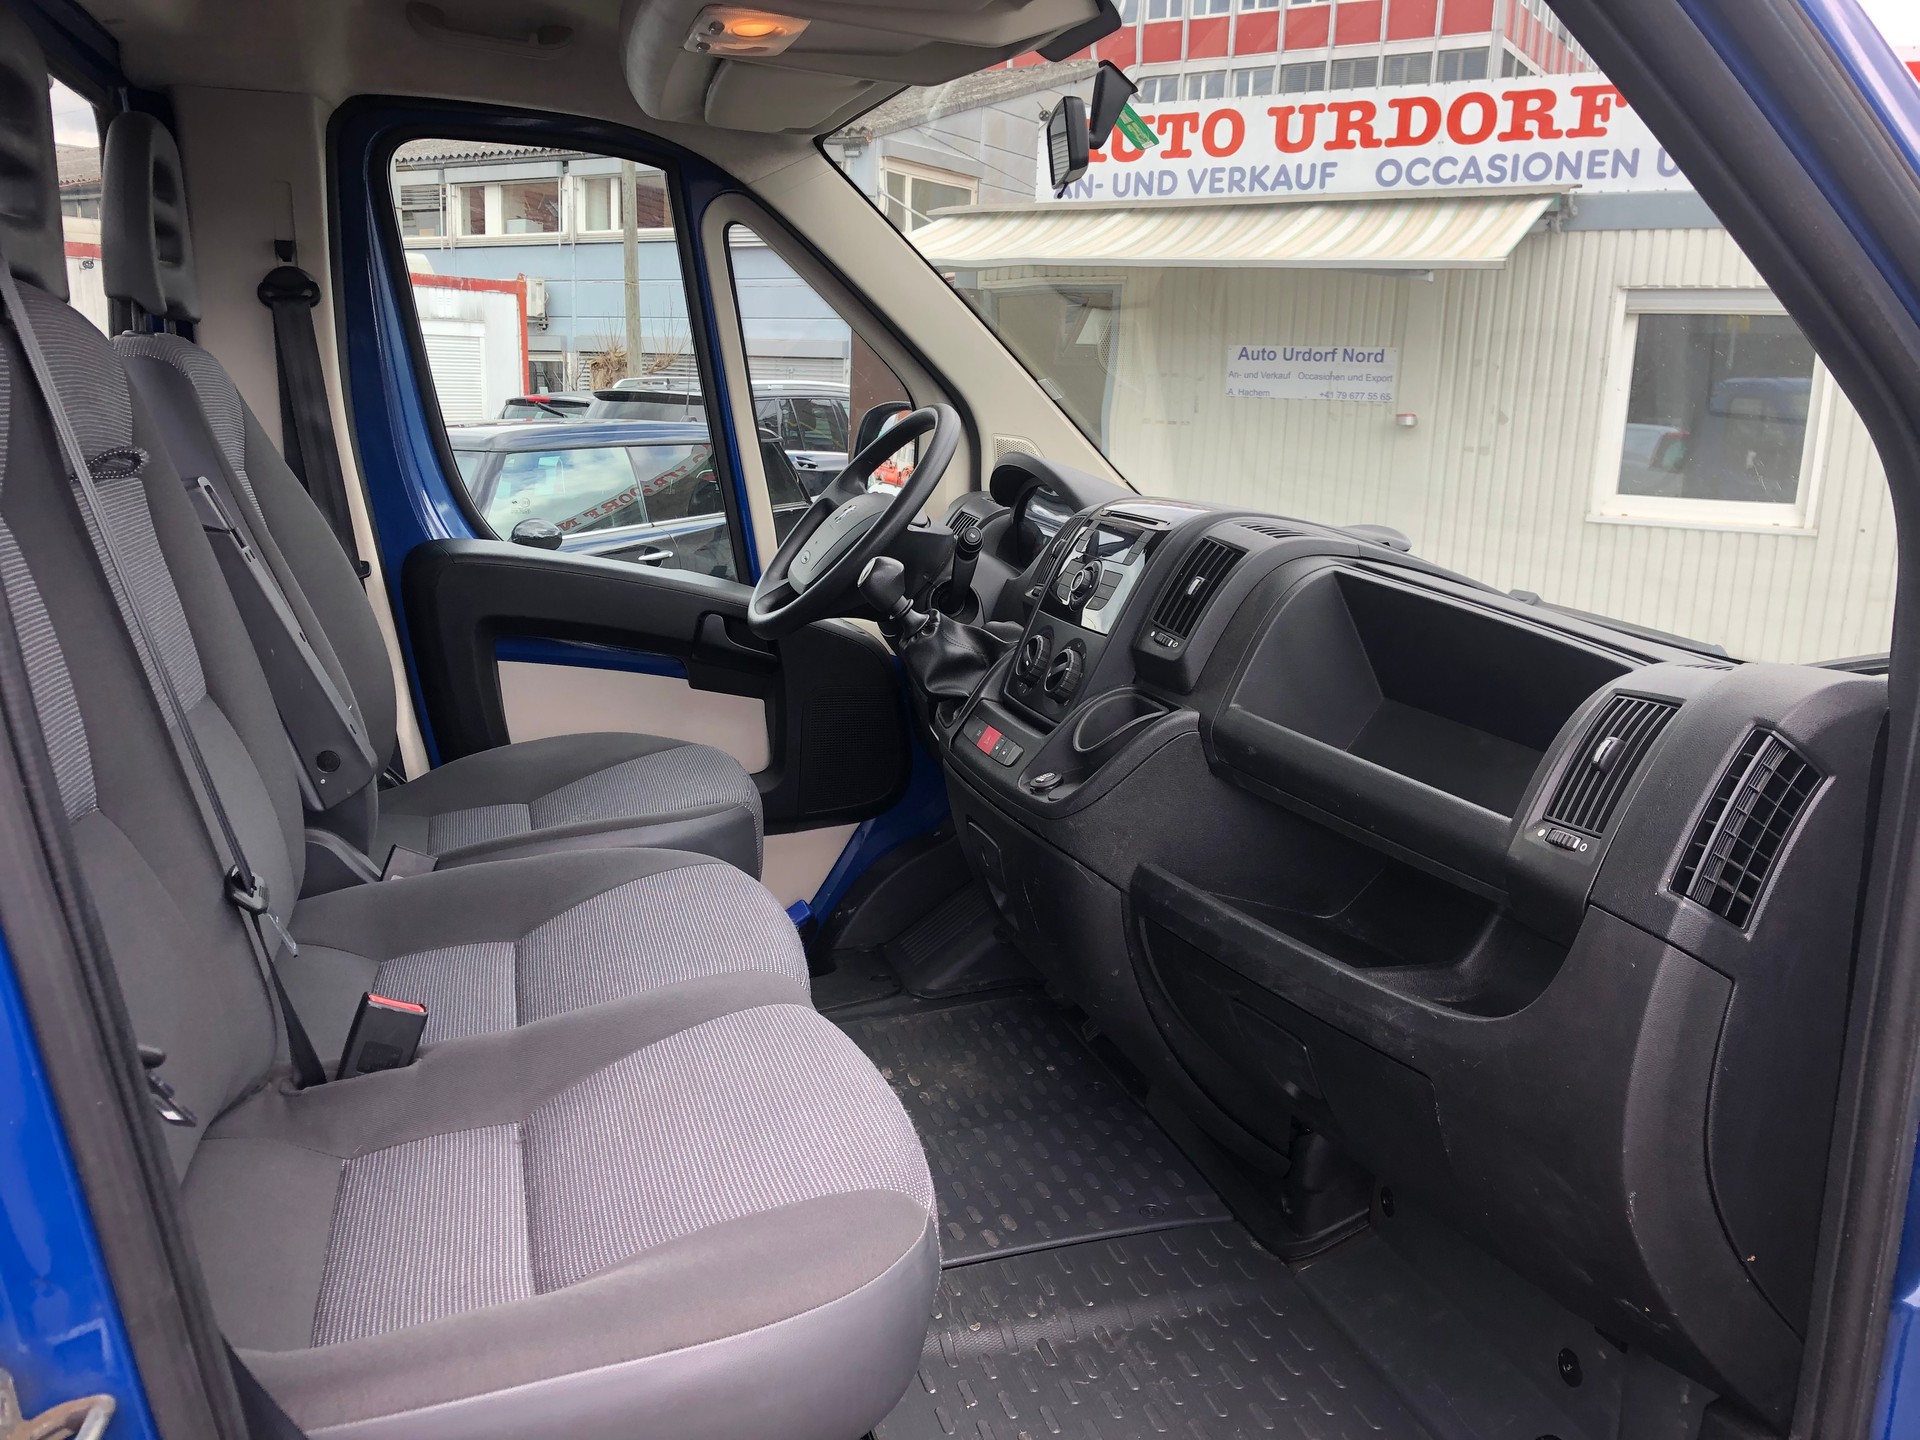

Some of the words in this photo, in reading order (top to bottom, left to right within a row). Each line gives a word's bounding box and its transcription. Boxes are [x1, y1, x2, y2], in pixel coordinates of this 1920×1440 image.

[1088, 108, 1245, 163] UTO
[1267, 84, 1629, 154] URDORF
[1113, 169, 1178, 198] UND
[1187, 161, 1338, 194] VERKAUF
[1375, 148, 1641, 188] OCCASIONEN
[1238, 346, 1277, 362] Auto
[1283, 347, 1338, 363] Urdorf
[1342, 348, 1385, 364] Nord
[1228, 371, 1242, 379] An-
[1244, 371, 1259, 380] und
[1261, 371, 1291, 380] Verkauf
[1297, 372, 1346, 382] Occasionen
[1348, 374, 1363, 383] und
[1366, 374, 1393, 384] Export
[1238, 388, 1271, 397] Hachem
[1319, 391, 1334, 399] +41
[1336, 391, 1347, 400] 79
[1349, 391, 1366, 400] 677
[1367, 392, 1379, 401] 55
